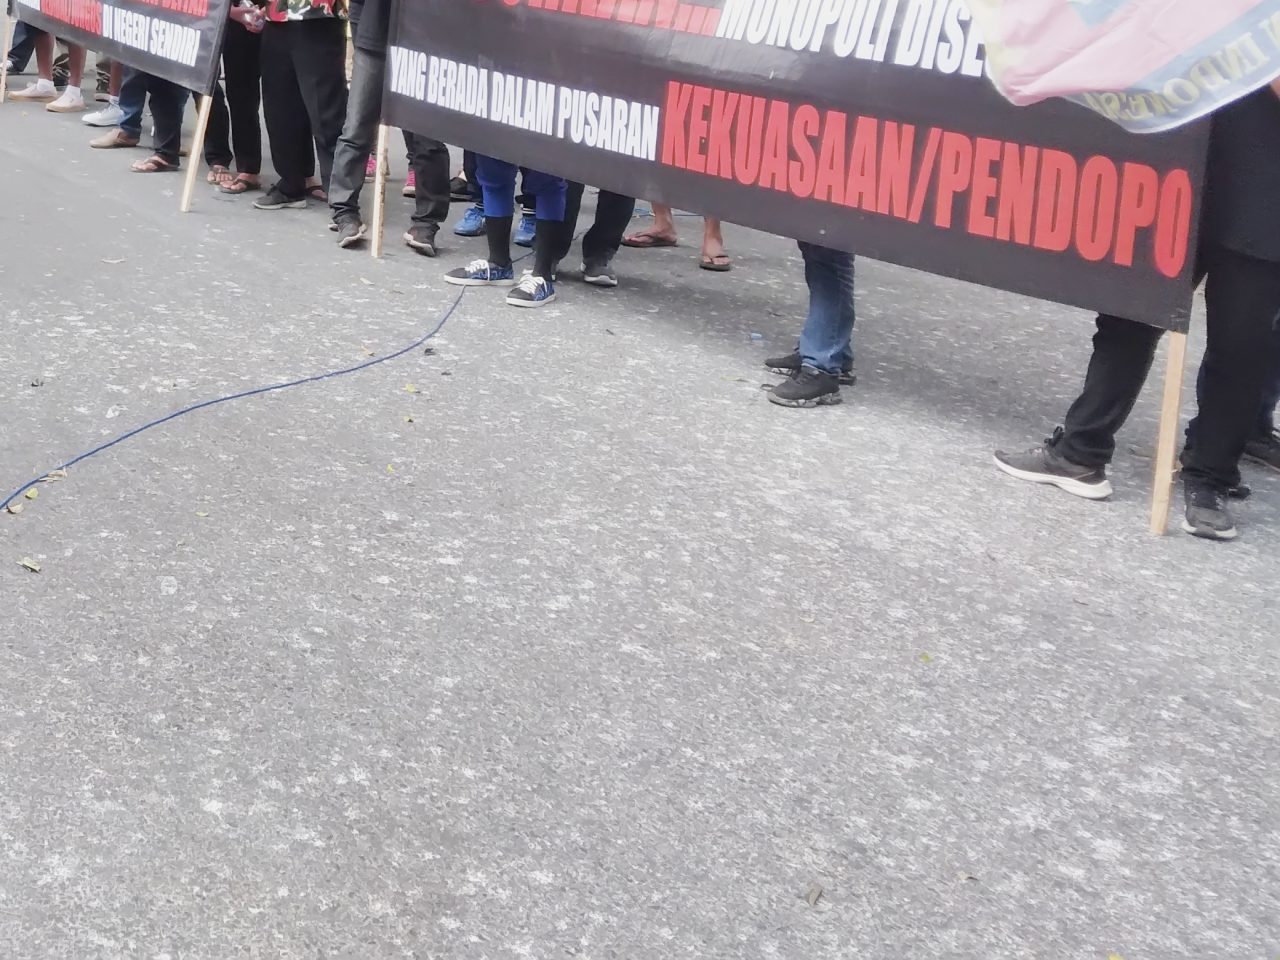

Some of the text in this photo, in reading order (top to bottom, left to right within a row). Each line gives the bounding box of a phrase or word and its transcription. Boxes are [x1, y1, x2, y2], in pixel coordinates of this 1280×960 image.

[102, 2, 114, 40] DI
[113, 6, 151, 52] NEGERI
[149, 17, 201, 68] SENDIRI
[390, 45, 1192, 279] YANG BERADA DALAM PUSARAN KEKUASAAN/PENDOPO
